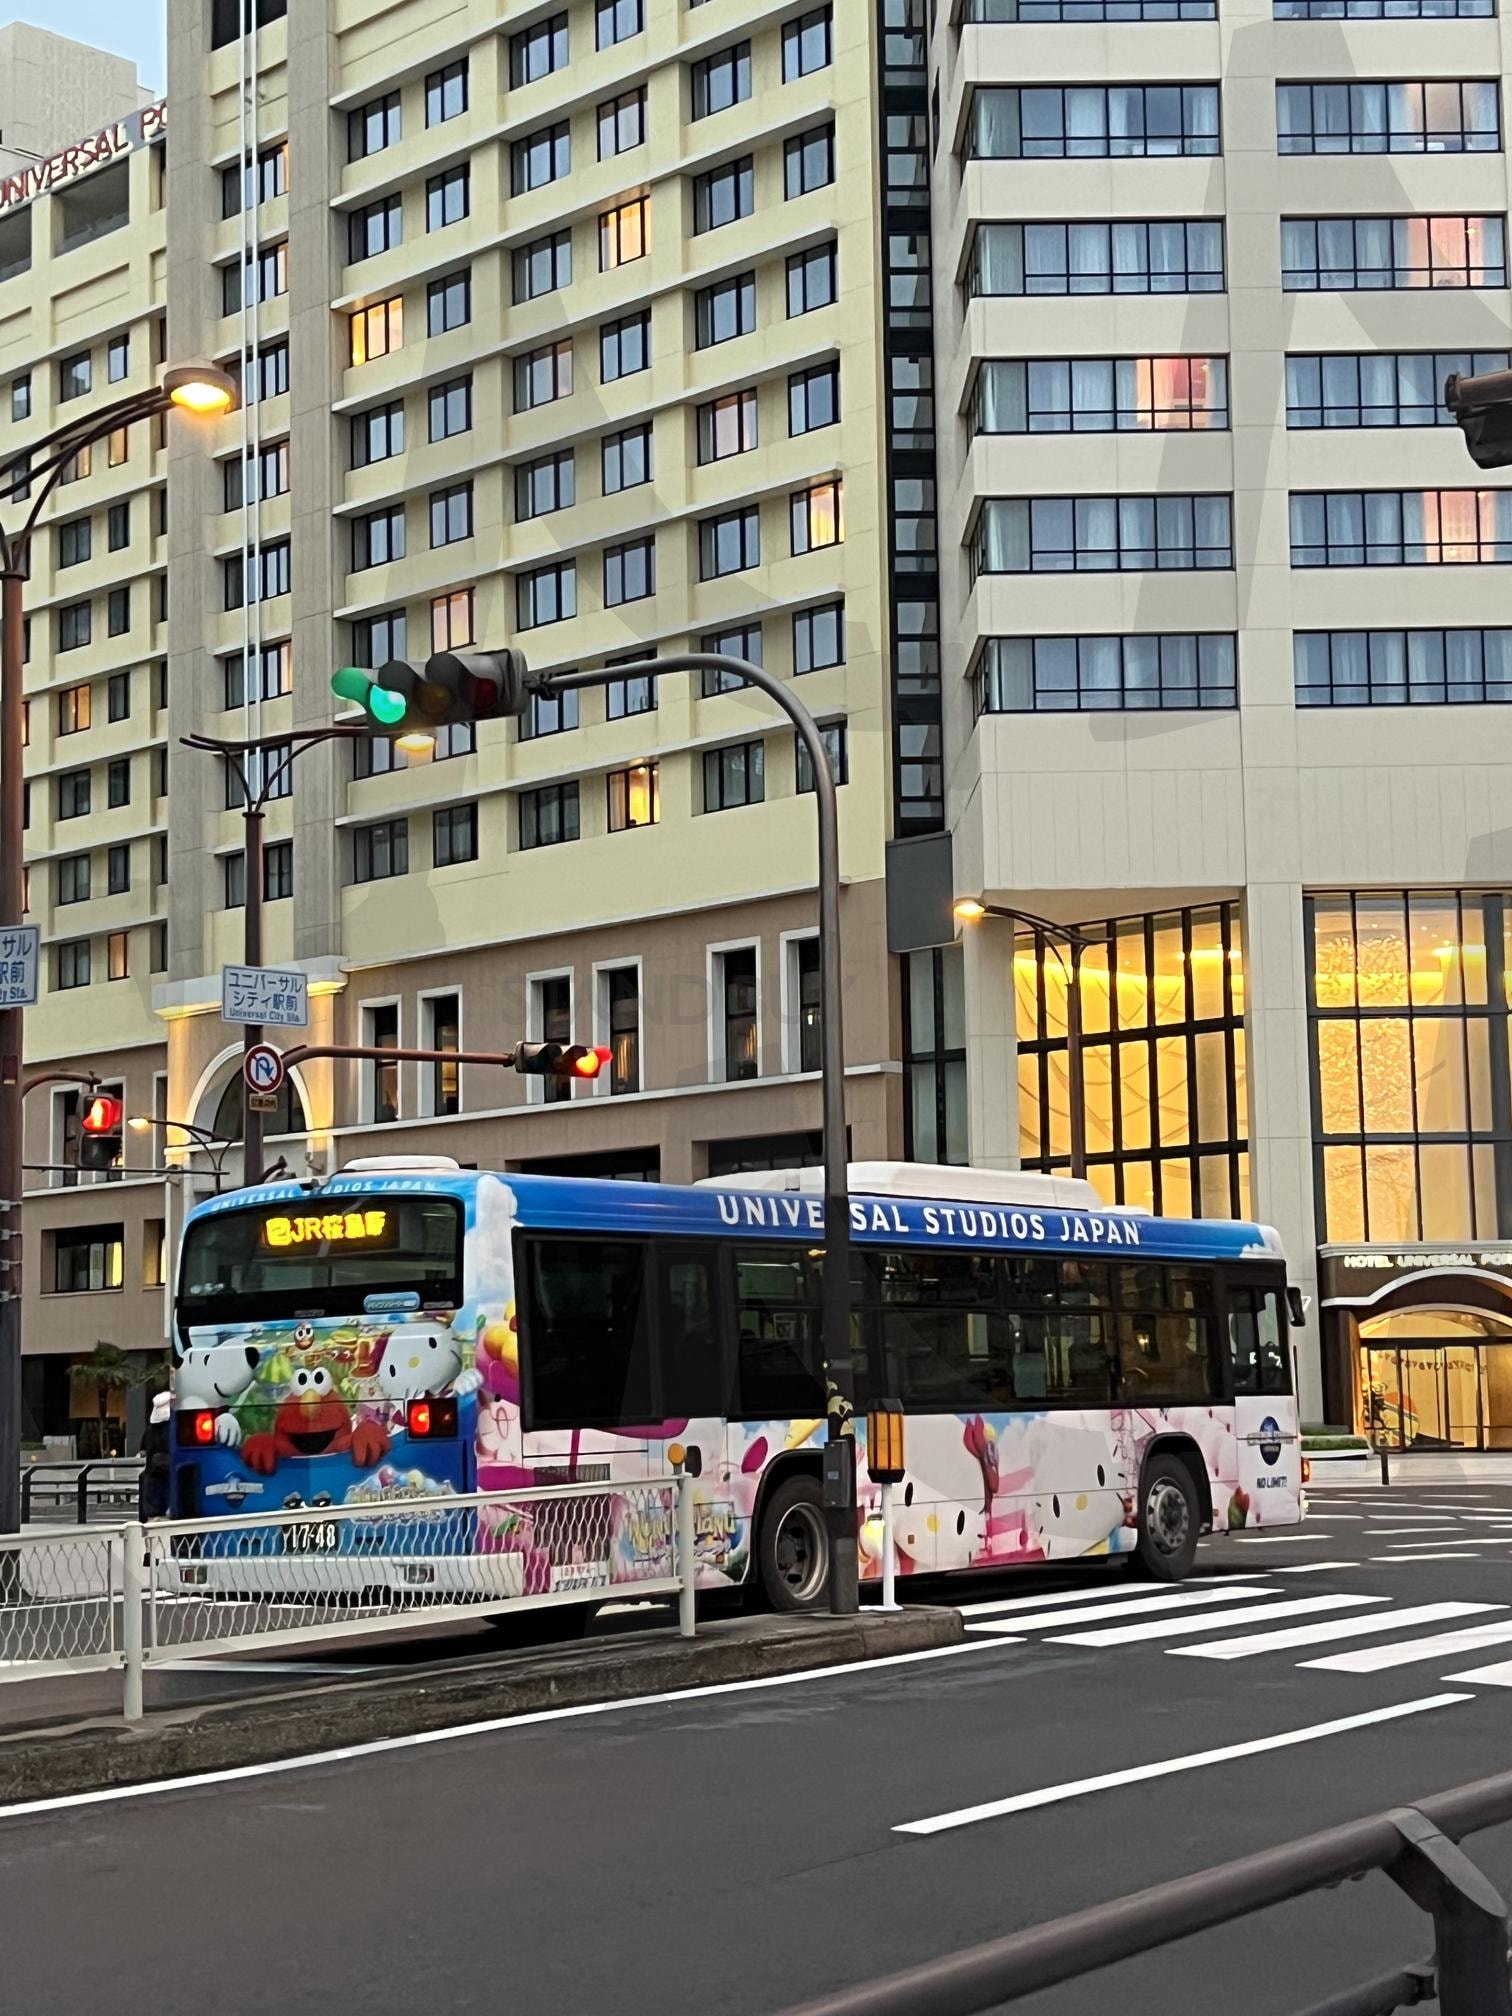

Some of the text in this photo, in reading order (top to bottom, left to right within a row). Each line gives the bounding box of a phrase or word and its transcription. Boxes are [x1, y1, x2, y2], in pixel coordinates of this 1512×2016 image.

[0, 121, 129, 208] UNIVERSAL
[211, 1187, 295, 1212] UNIVERSAL
[379, 1180, 437, 1193] JAPAN
[717, 1195, 1141, 1246] UNIVESAL STUDIOS JAPAN
[1343, 1254, 1395, 1268] HOTEL
[1397, 1253, 1477, 1268] UNIVERSAL
